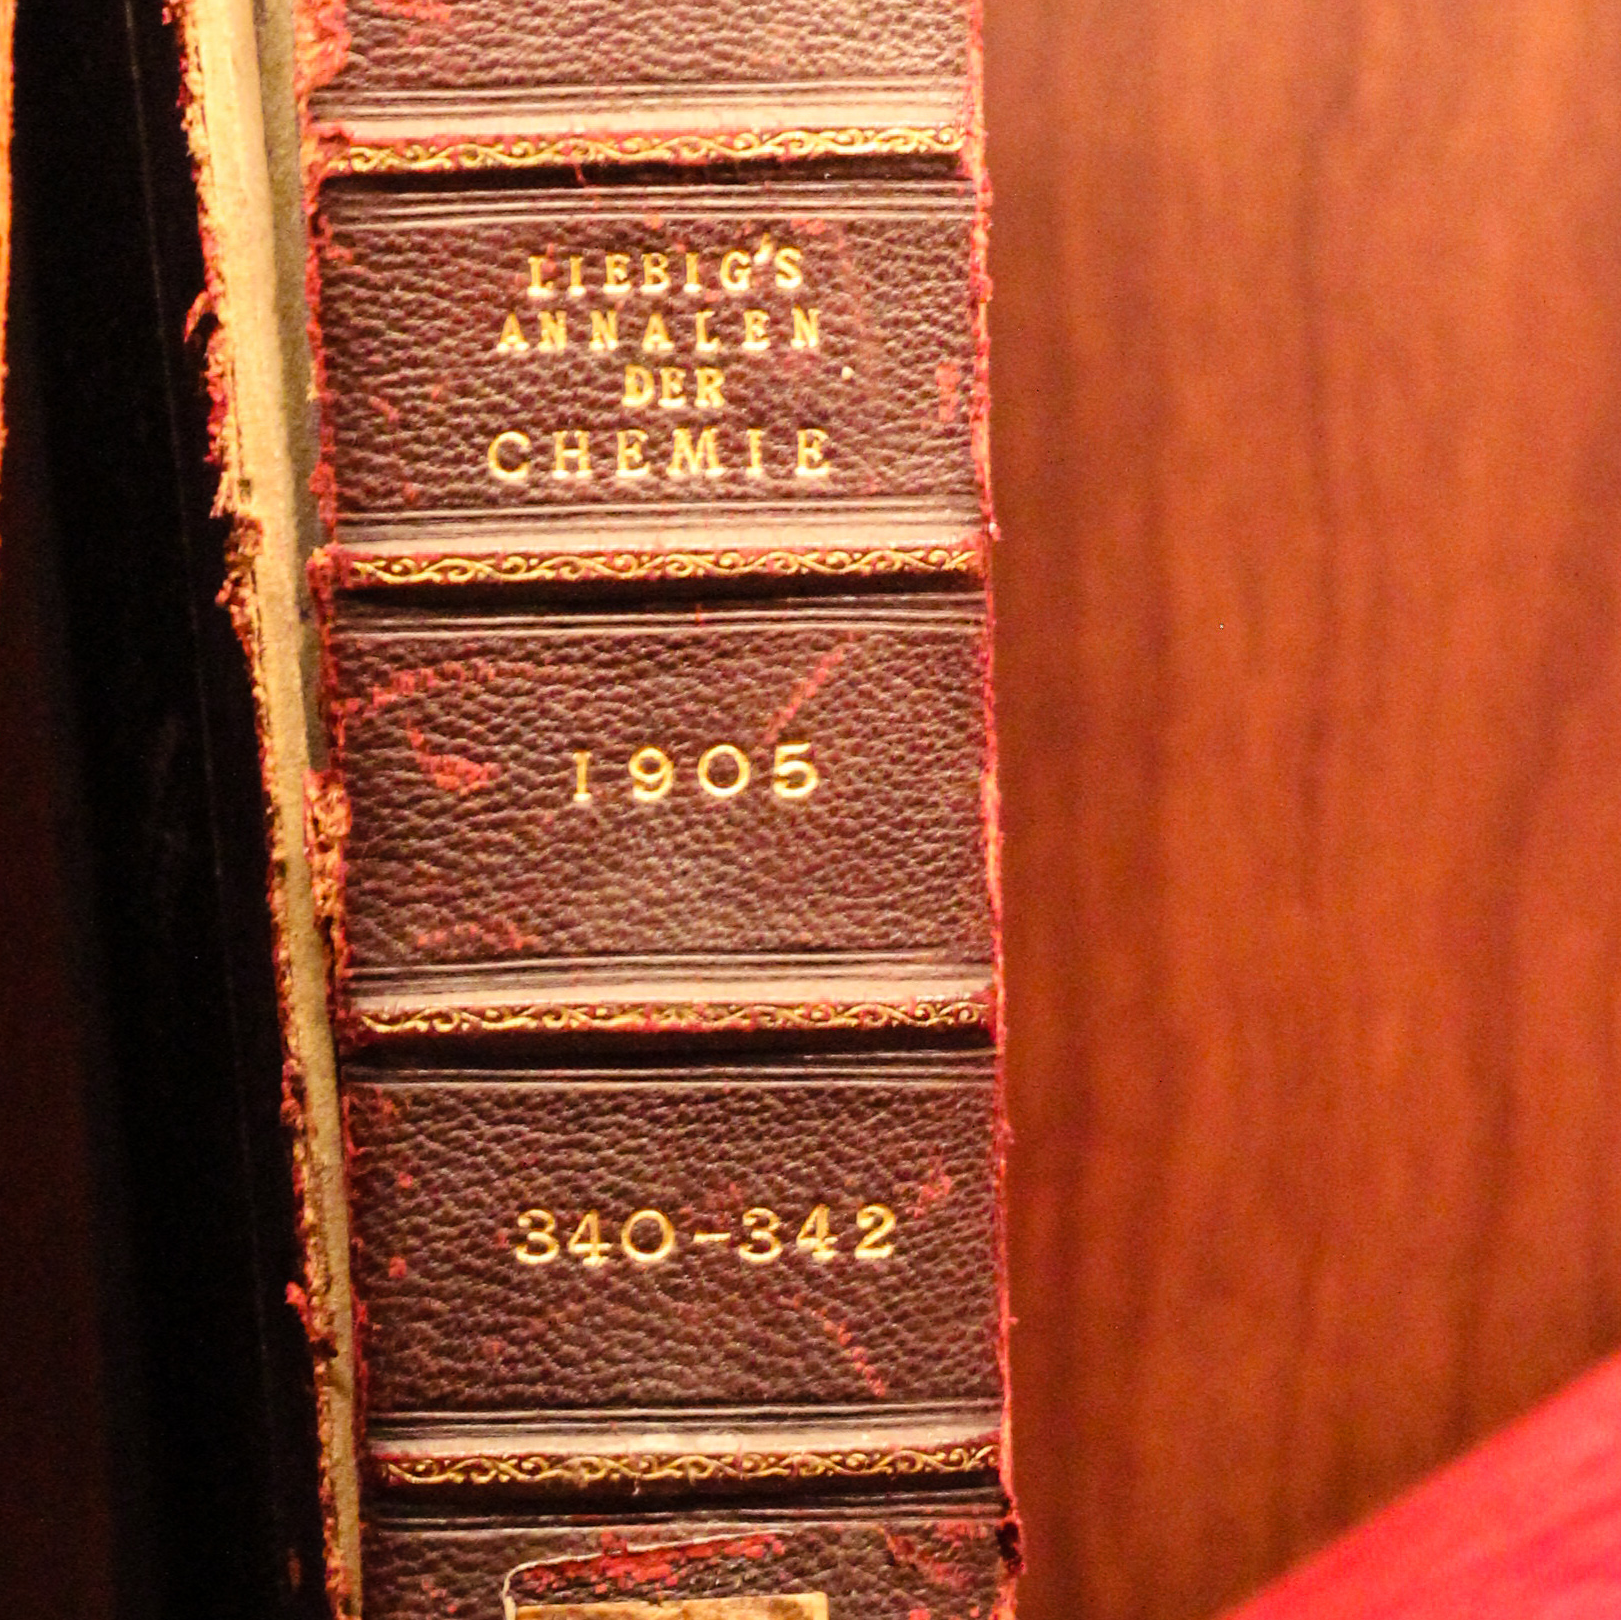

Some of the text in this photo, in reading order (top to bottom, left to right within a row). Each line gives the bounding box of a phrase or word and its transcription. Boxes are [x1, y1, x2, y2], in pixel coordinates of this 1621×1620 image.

[527, 233, 805, 297] LIEBIG'S
[496, 305, 821, 353] ANNALEN
[621, 364, 727, 409] DER
[487, 425, 831, 481] CHEMIE
[572, 740, 820, 803] 1905
[514, 1204, 898, 1267] 340-342
